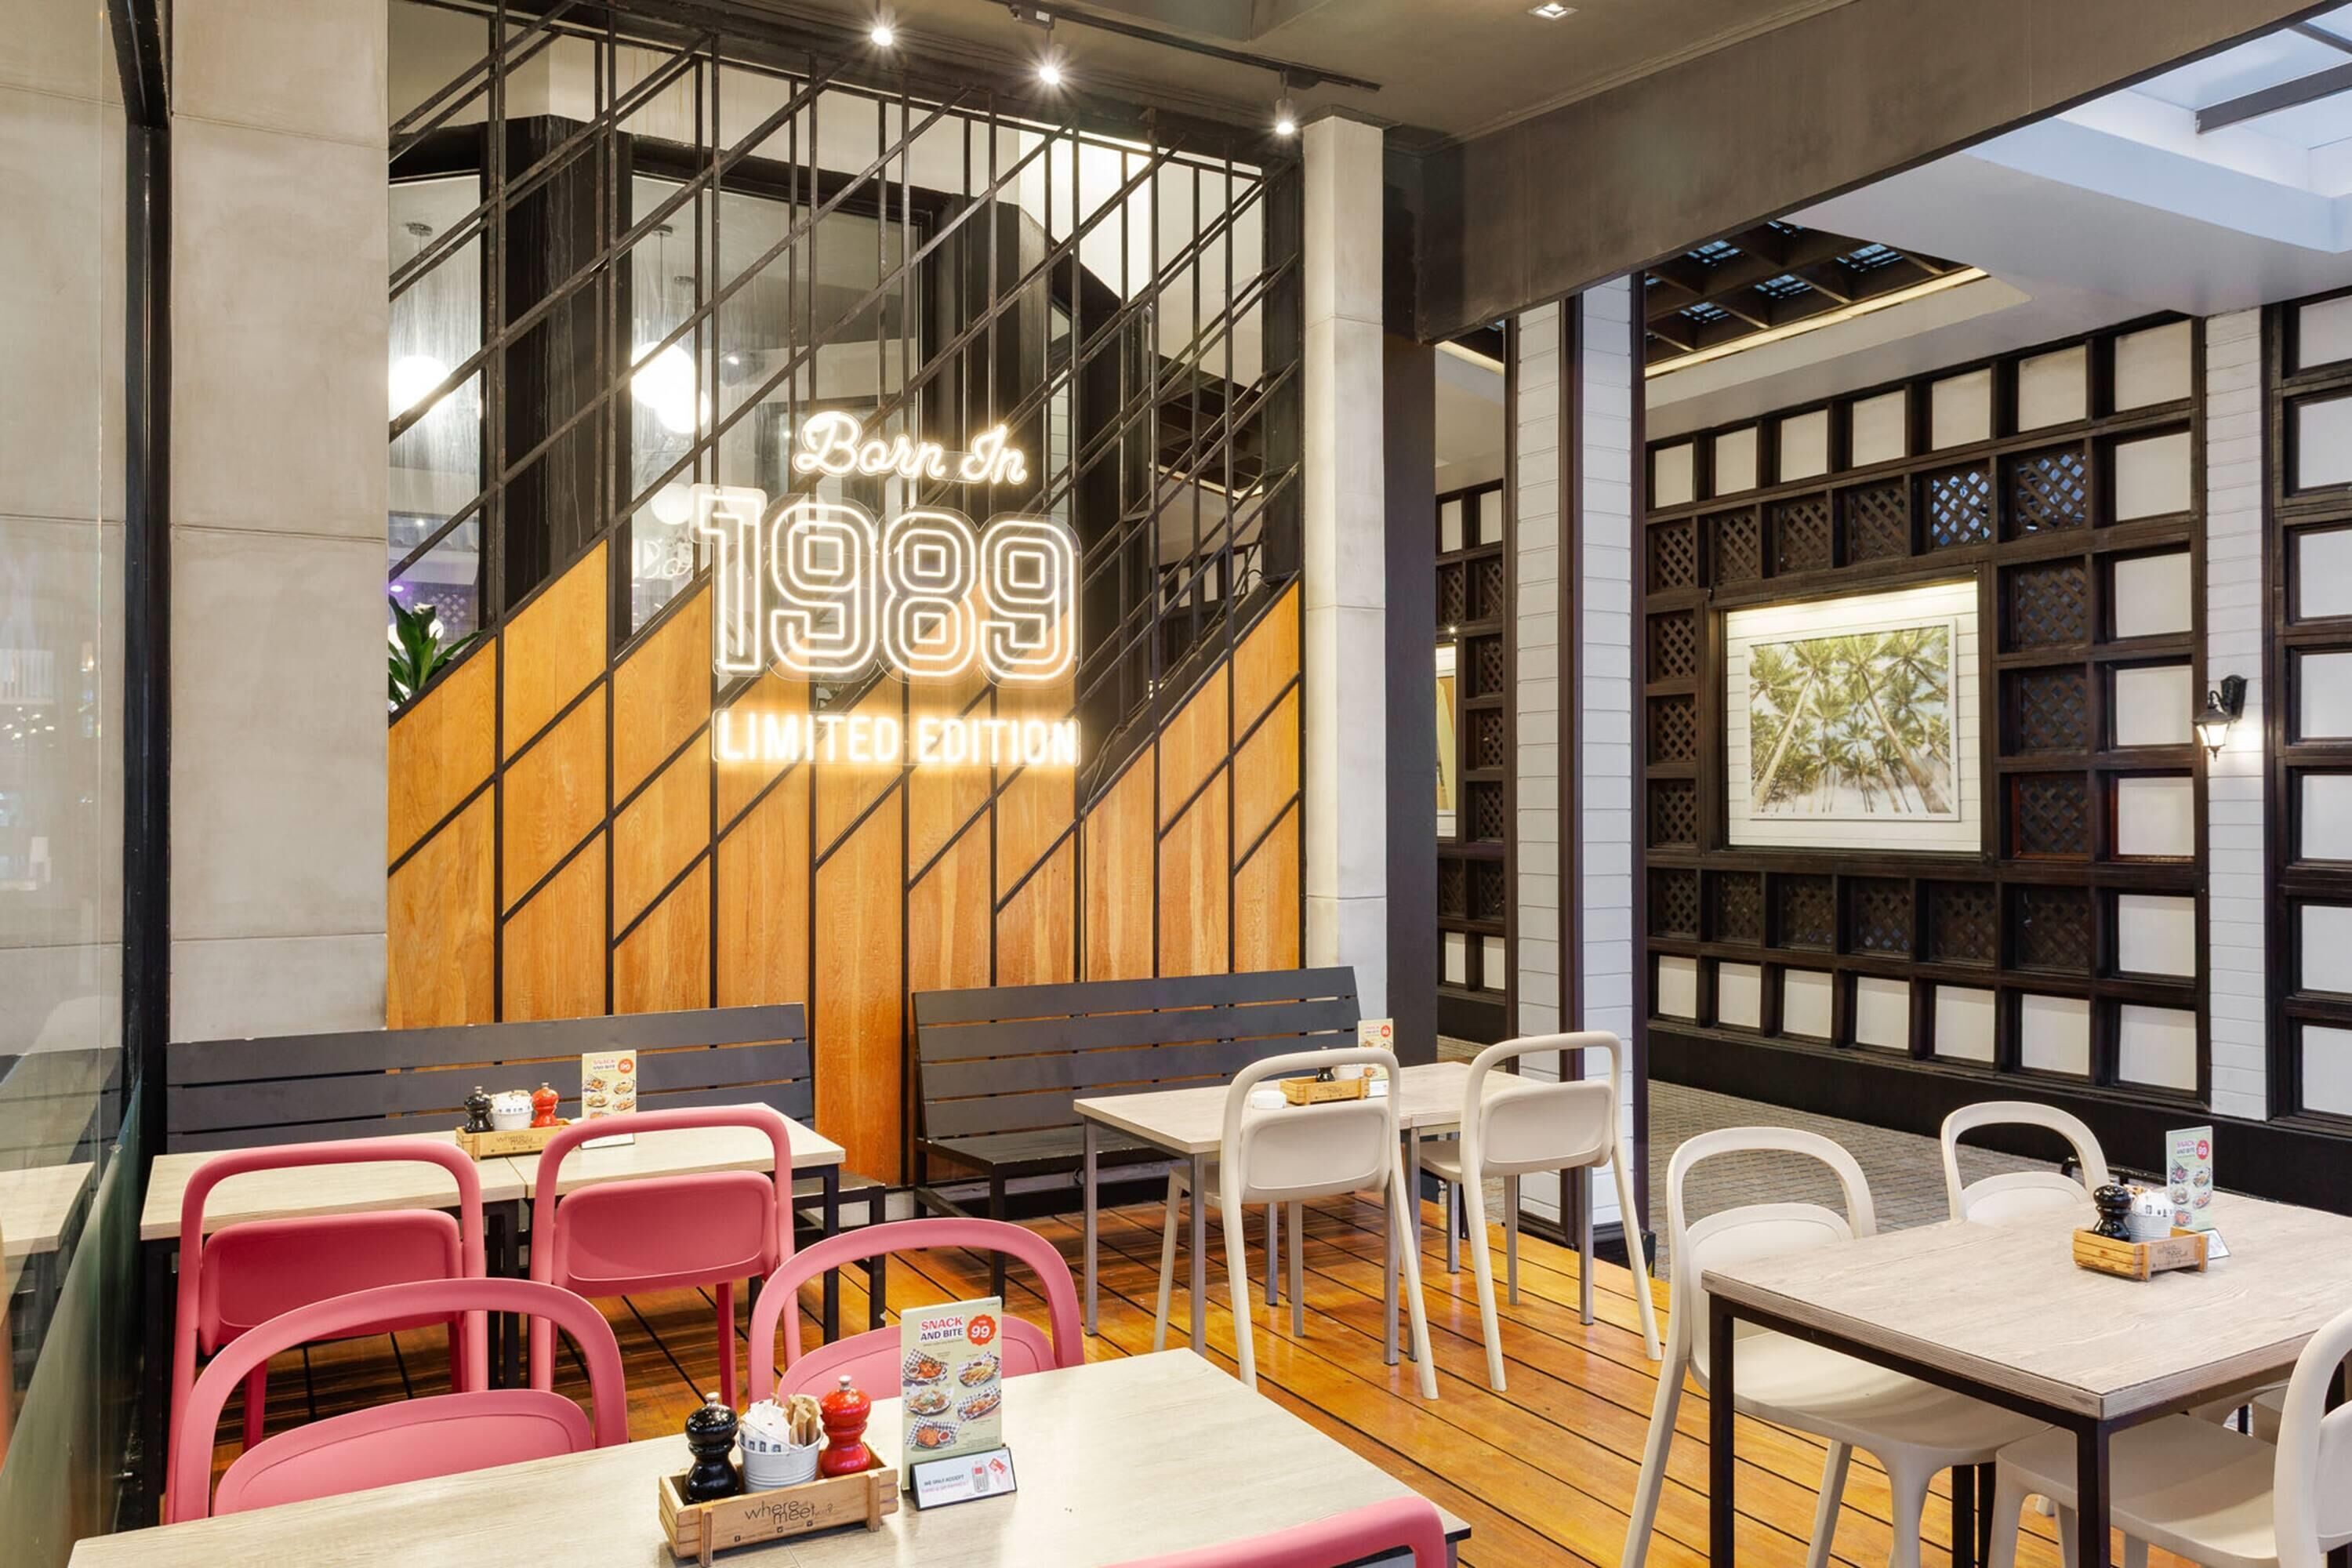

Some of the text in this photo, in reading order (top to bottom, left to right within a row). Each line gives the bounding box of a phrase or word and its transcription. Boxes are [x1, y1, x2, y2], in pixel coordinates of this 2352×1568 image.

[794, 411, 1028, 484] Born In
[699, 495, 1075, 681] 1989
[718, 711, 1077, 765] LIMITED EDITION
[921, 1316, 963, 1330] SNACK
[971, 1325, 990, 1338] 99
[920, 1328, 963, 1341] AND BITE
[745, 1501, 799, 1519] where
[773, 1504, 815, 1525] meet
